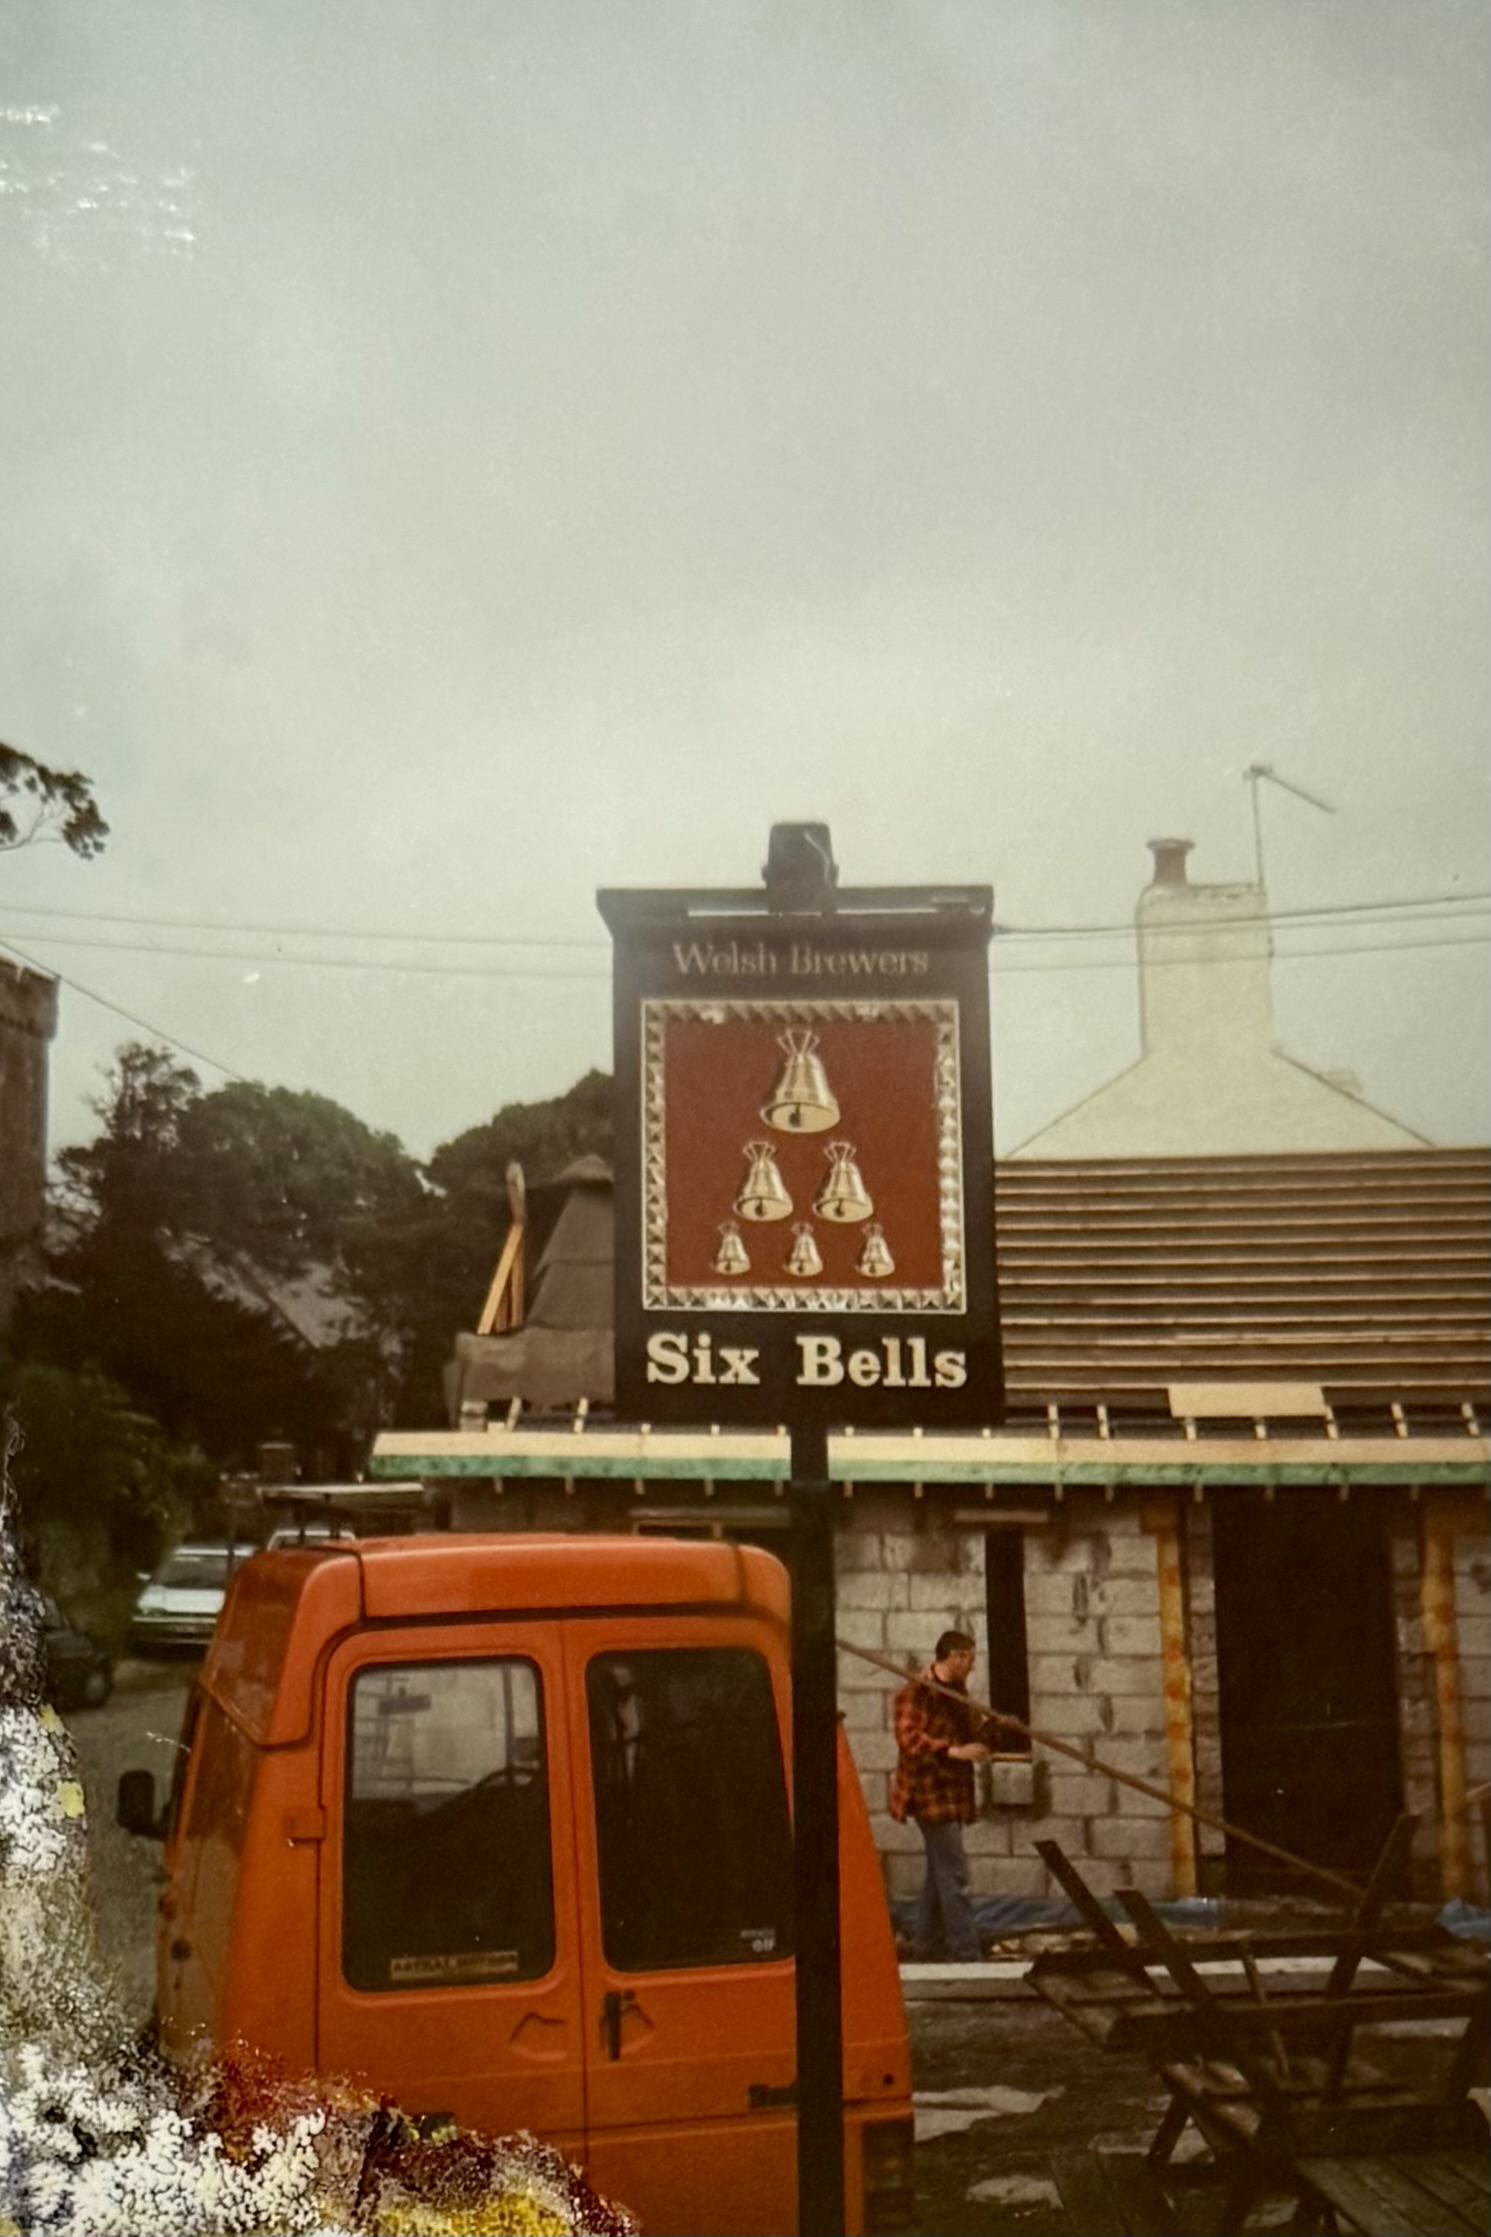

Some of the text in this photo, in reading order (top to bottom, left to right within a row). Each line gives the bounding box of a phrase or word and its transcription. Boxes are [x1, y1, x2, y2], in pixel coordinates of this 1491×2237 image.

[672, 941, 929, 975] Welsh Brewers
[646, 1332, 968, 1387] Six Bells
